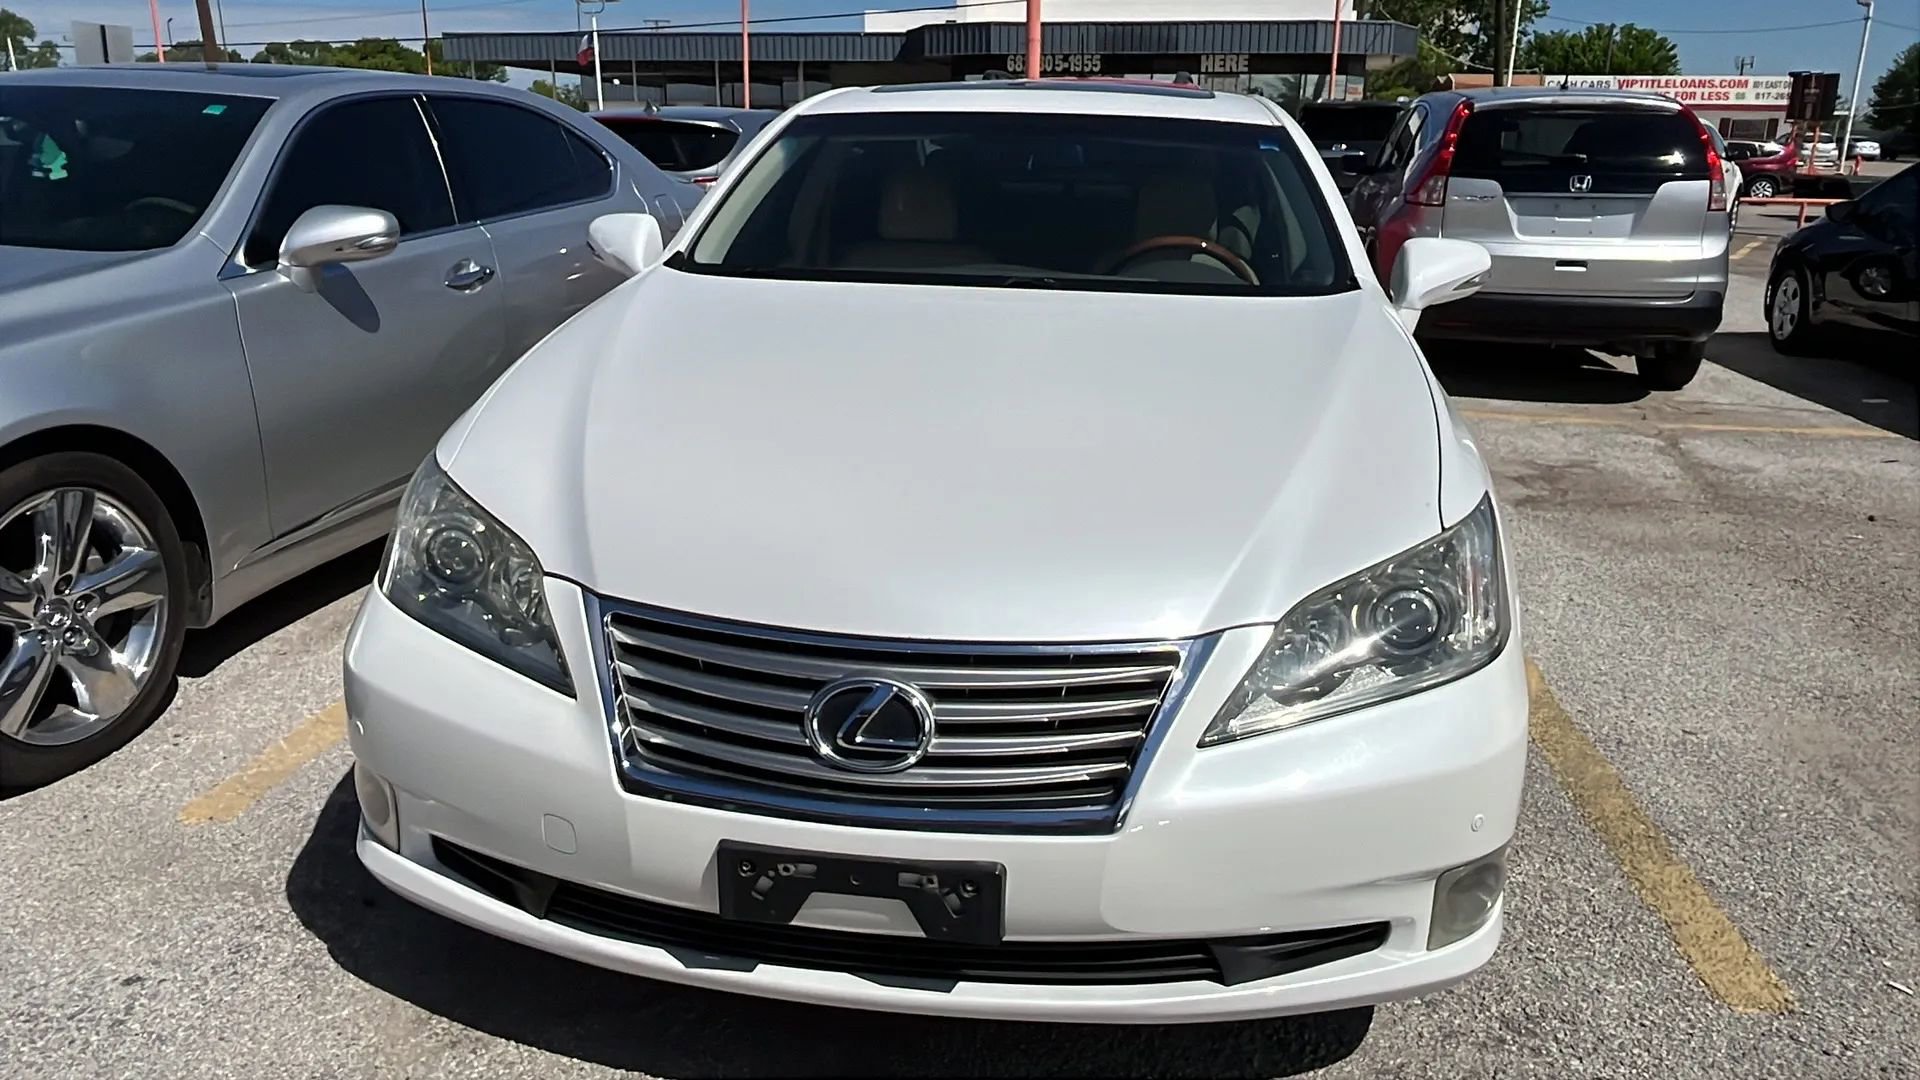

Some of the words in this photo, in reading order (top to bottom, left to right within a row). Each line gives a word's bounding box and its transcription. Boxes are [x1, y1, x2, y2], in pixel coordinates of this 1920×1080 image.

[1201, 54, 1249, 72] HERE
[1548, 80, 1577, 88] CAH
[1617, 79, 1749, 89] VIPTITLELOANS.COM
[1765, 80, 1782, 88] EAST
[1674, 91, 1697, 100] FOR
[1701, 92, 1730, 101] LESS
